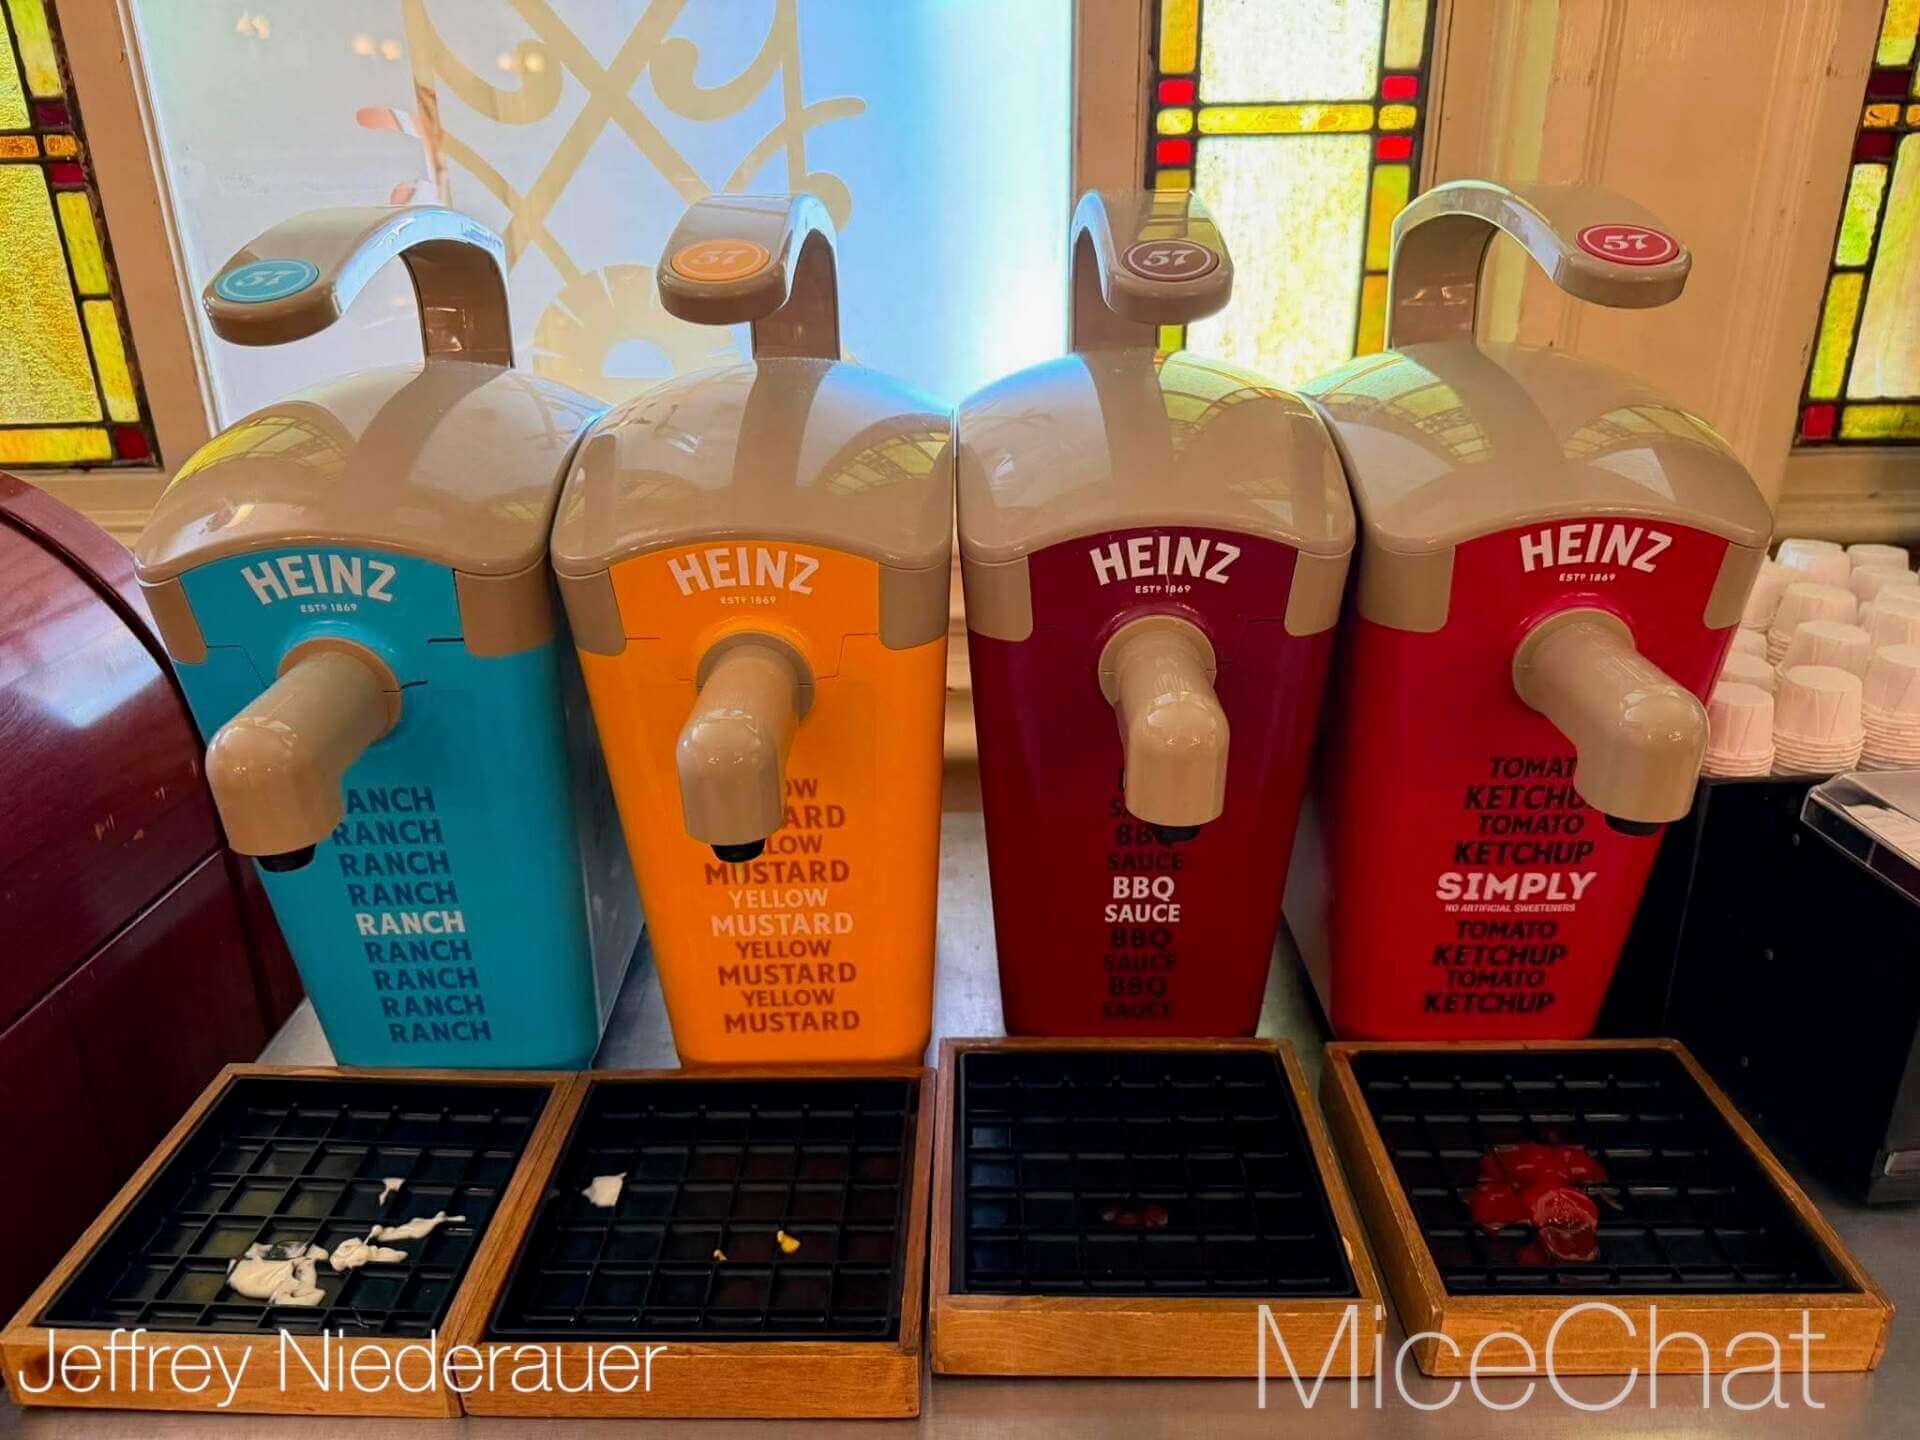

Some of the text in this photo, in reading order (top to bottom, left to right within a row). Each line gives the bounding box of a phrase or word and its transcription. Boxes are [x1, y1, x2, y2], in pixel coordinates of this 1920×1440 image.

[1602, 234, 1649, 251] 57
[1142, 249, 1196, 267] 57
[235, 269, 301, 288] 57
[1520, 523, 1673, 573] HEINZ
[667, 547, 820, 597] HEINZ
[1089, 535, 1241, 586] HEINZ
[240, 554, 397, 606] HEINZ
[1590, 572, 1617, 582] 1869
[751, 596, 777, 605] 1869
[1165, 585, 1192, 594] 1869
[331, 603, 358, 613] 1869
[1490, 757, 1578, 778] TOMAT
[346, 786, 436, 815] ANCH
[1464, 784, 1587, 811] KETCHU
[331, 819, 444, 847] RANCH
[1478, 814, 1585, 836] TOMATO
[338, 851, 453, 877] RANCH
[1107, 852, 1184, 871] SAUCE
[1454, 840, 1596, 866] KETCHUP
[347, 880, 460, 907] RANCH
[1112, 875, 1175, 901] BBQ
[1436, 871, 1597, 901] SIMPLY
[728, 888, 829, 910] YELLOW
[1444, 903, 1459, 913] NO
[1460, 903, 1512, 913] ARTIFICIAL
[355, 910, 466, 936] RANCH
[711, 911, 854, 937] MUSTARD
[1104, 903, 1181, 923] SAUCE
[1111, 928, 1172, 949] BBQ
[1456, 920, 1558, 940] TOMATO
[364, 939, 473, 964] RANCH
[735, 939, 832, 960] YELLOW
[1432, 944, 1568, 966] KETCHUP
[1104, 953, 1176, 972] SAUCE
[373, 966, 480, 991] RANCH
[717, 962, 857, 987] MUSTARD
[1447, 969, 1547, 988] TOMATO
[741, 988, 836, 1008] YELLOW
[1108, 976, 1167, 999] BBQ
[380, 994, 486, 1018] RANCH
[1424, 991, 1556, 1014] KETCHUP
[388, 1020, 493, 1044] RANCH
[724, 1010, 860, 1035] MUSTARD
